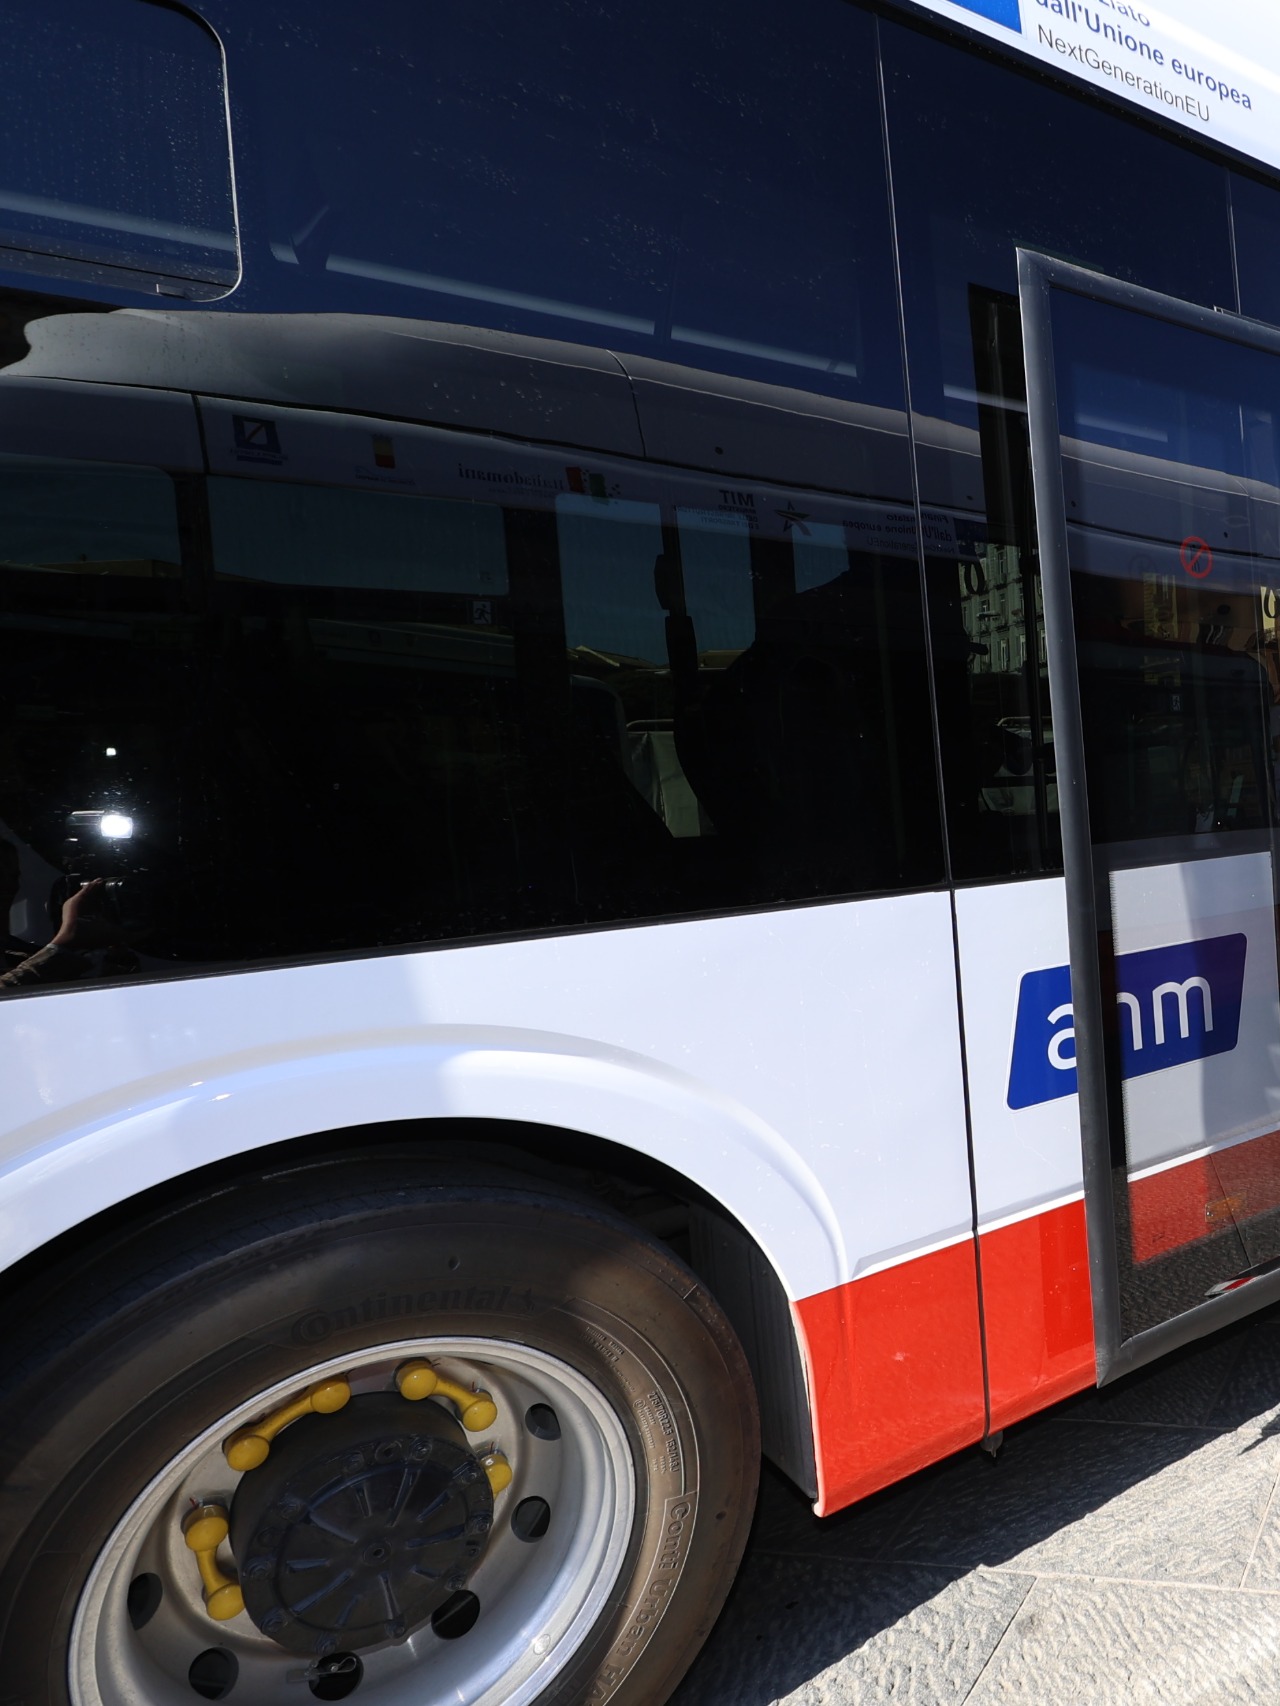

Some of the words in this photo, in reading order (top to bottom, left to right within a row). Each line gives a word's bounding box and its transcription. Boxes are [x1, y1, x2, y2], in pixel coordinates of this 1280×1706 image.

[1038, 25, 1210, 123] NextGenerationEU
[1172, 58, 1252, 110] europea
[658, 1501, 691, 1570] Conti
[616, 1578, 673, 1657] Urban
